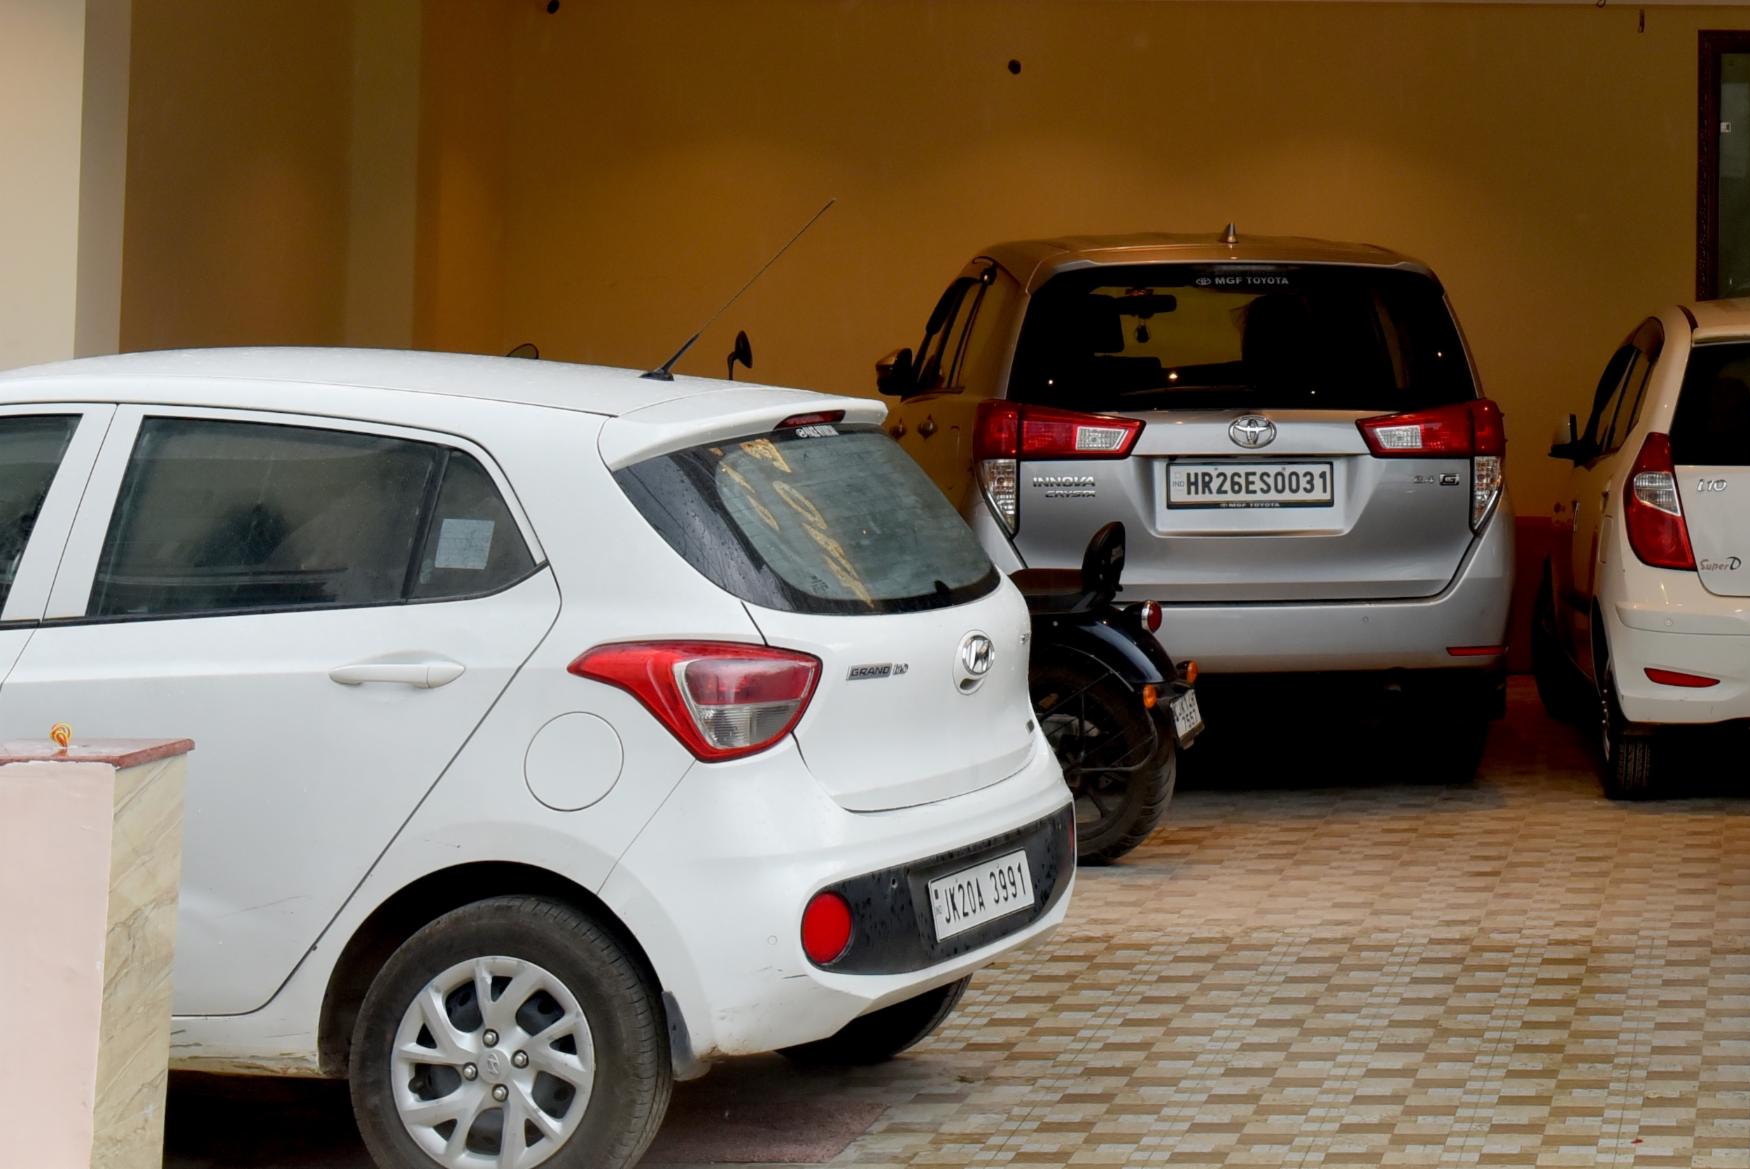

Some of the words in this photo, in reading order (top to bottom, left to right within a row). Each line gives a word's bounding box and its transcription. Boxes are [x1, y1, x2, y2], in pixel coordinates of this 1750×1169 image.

[1214, 276, 1243, 285] MGF
[1247, 276, 1290, 286] TOYOTA
[1032, 476, 1096, 488] INNOVA
[1186, 471, 1328, 496] HR26ES0031
[849, 664, 892, 678] GRAND
[944, 877, 986, 924] JK20A
[989, 861, 1026, 905] 3991
